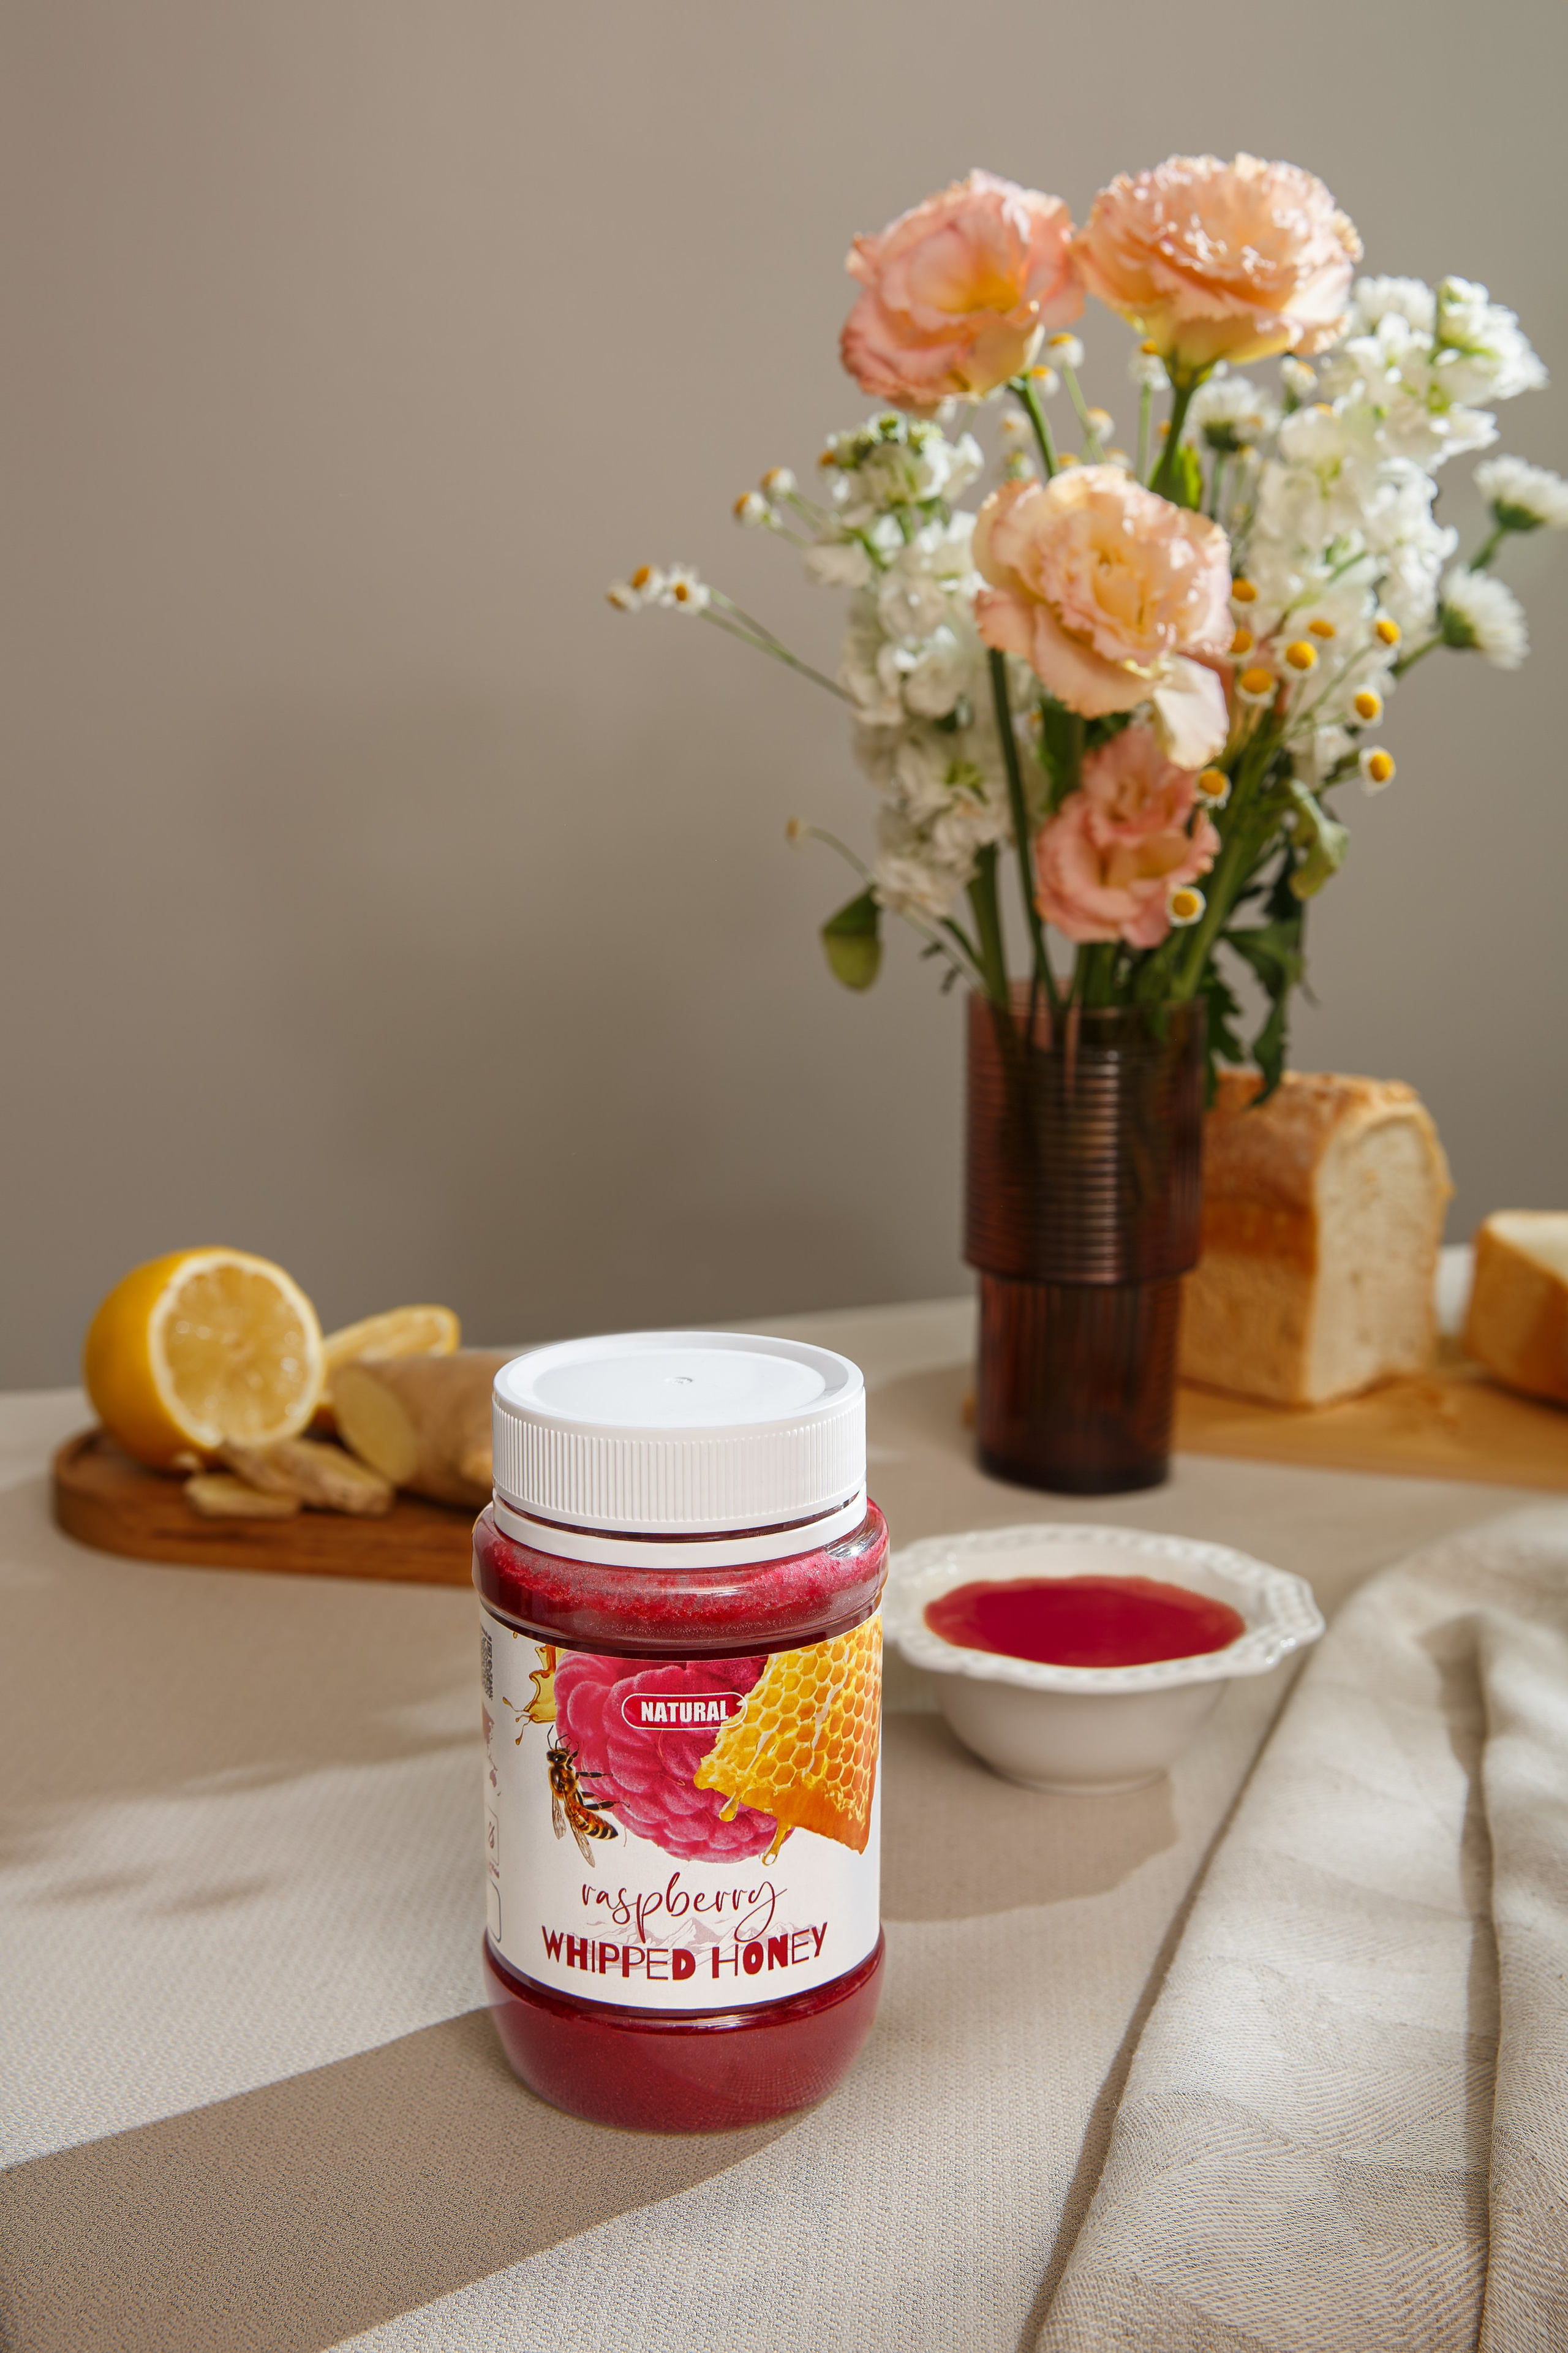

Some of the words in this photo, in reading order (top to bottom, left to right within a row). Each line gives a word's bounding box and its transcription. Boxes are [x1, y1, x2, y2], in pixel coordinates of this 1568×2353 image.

[641, 1700, 729, 1723] NATURAL
[581, 1872, 788, 1944] raspberry
[541, 1925, 696, 1981] WHIPPED
[711, 1921, 828, 1979] HONEY
